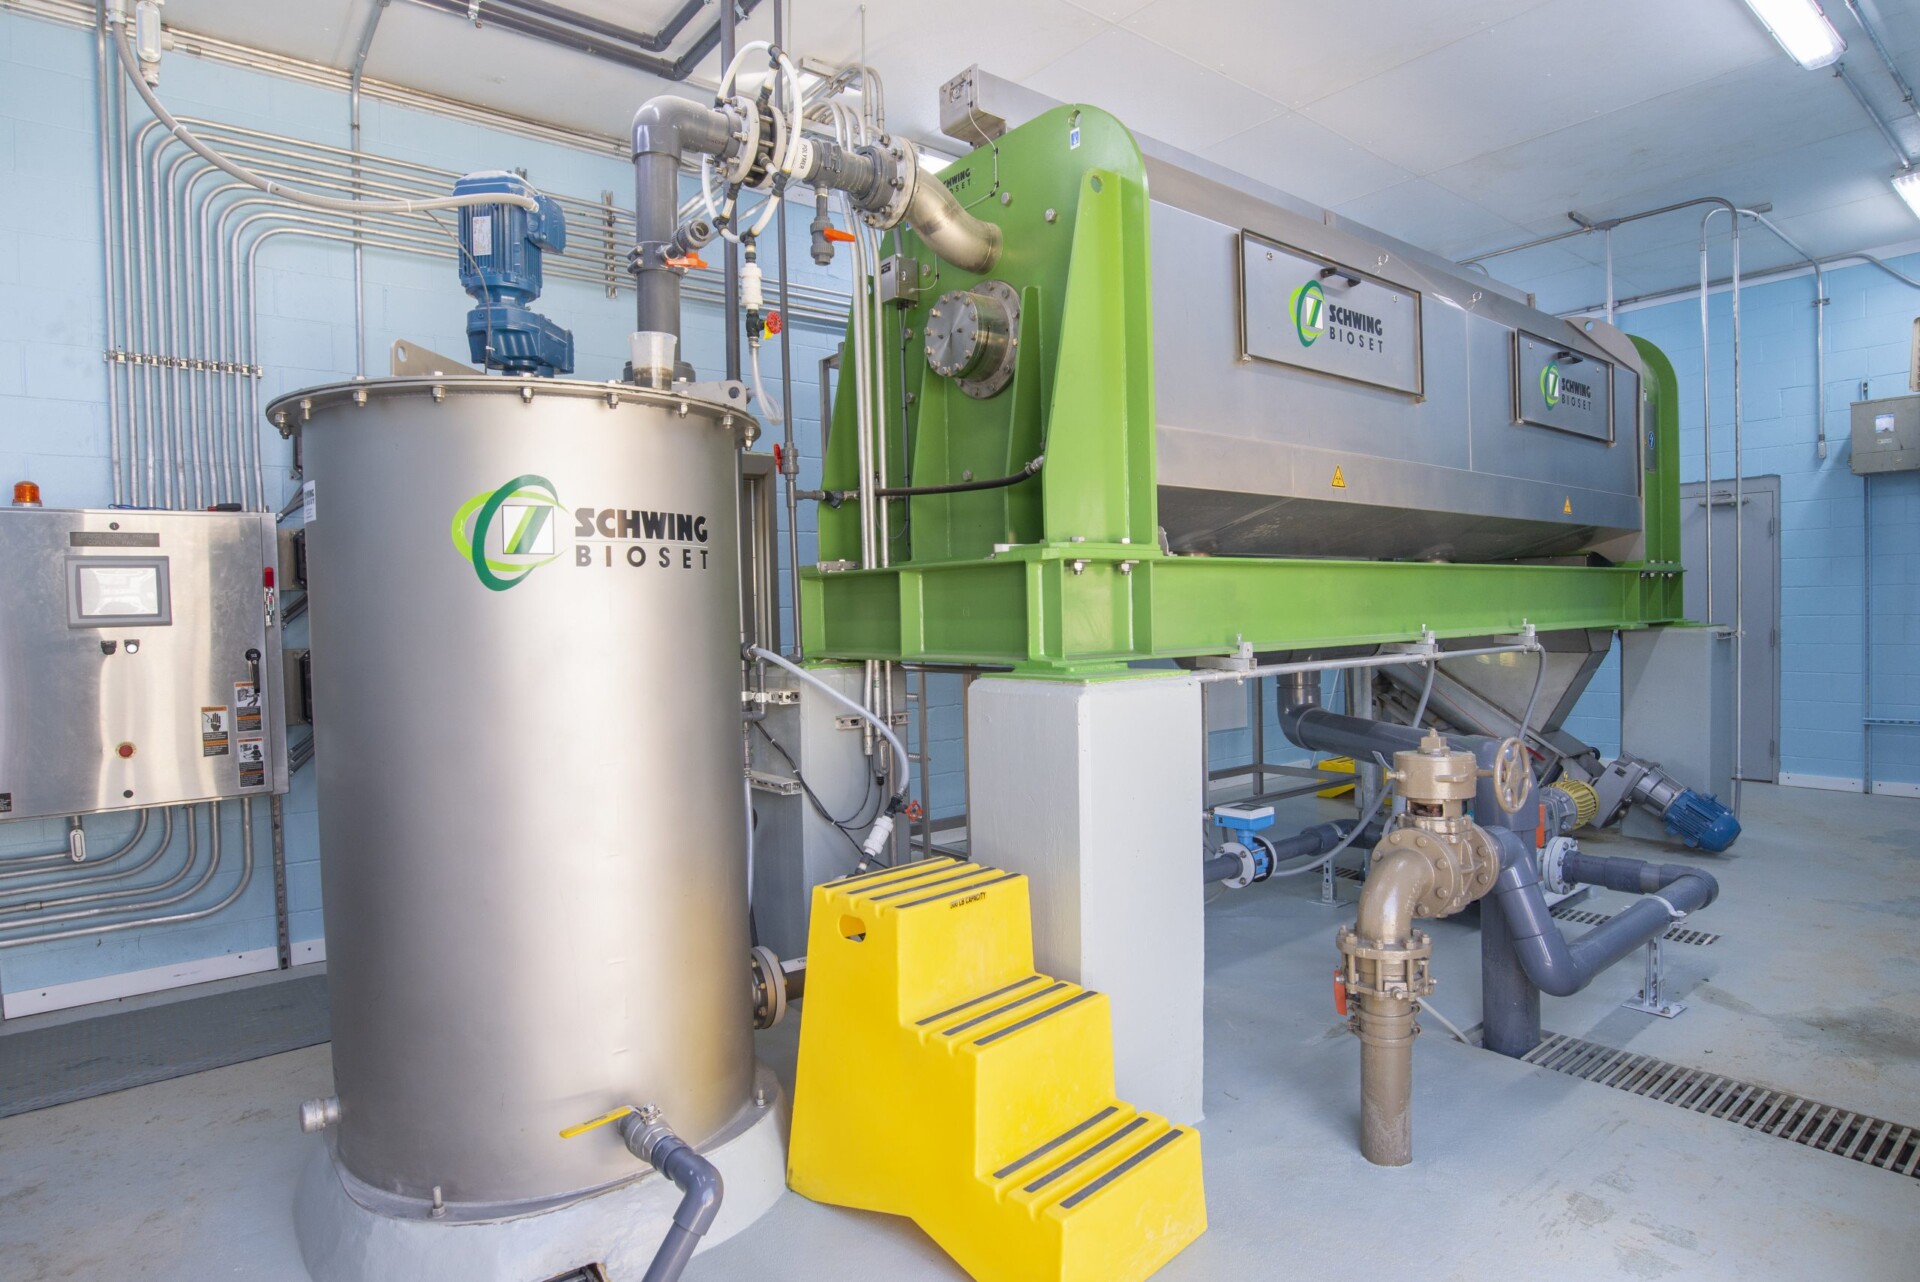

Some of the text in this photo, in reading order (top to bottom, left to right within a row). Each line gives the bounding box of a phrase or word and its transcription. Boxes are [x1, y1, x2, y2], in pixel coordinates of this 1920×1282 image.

[800, 144, 808, 170] POLYMER
[943, 168, 971, 189] HWING
[949, 178, 971, 194] OSET
[1329, 304, 1383, 336] SCHWING
[1329, 326, 1383, 353] BIOSET
[1561, 378, 1591, 398] SCHWING
[1561, 394, 1591, 411] BIOSET
[575, 507, 708, 543] SCHWING
[575, 545, 708, 570] BIOSET
